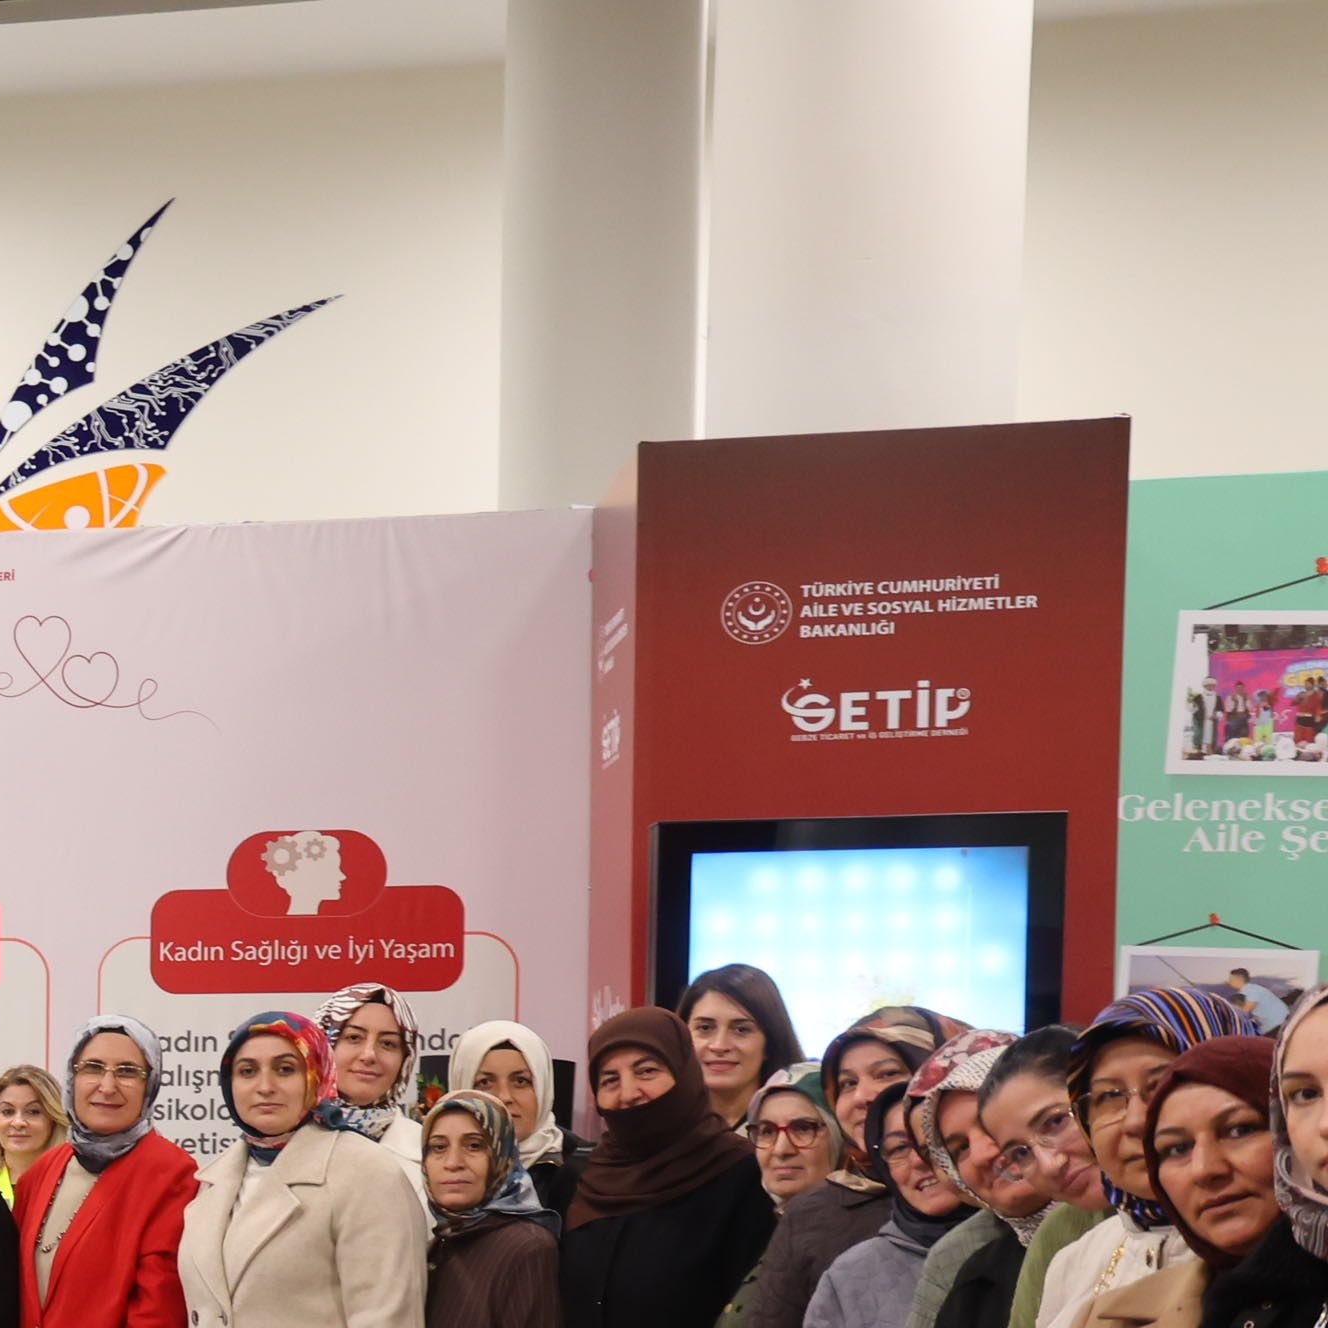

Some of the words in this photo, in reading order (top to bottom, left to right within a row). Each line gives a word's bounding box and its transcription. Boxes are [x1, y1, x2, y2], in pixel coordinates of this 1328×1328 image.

[800, 580, 874, 598] TÜRKİYE
[877, 574, 1000, 595] CUMHURİYETİ
[800, 602, 838, 618] AİLE
[840, 602, 864, 617] VE
[867, 599, 935, 616] SOSYAL
[937, 595, 1039, 613] HİZMETLER
[799, 619, 896, 638] BAKANLIĞI
[1117, 792, 1328, 822] Gelenekse
[1183, 822, 1266, 853] Aile
[158, 939, 224, 962] Kadın
[230, 939, 308, 966] Sağlığı
[315, 944, 342, 961] ve
[347, 935, 375, 966] İyi
[382, 938, 455, 965] Yaşam
[158, 1030, 218, 1053] adın
